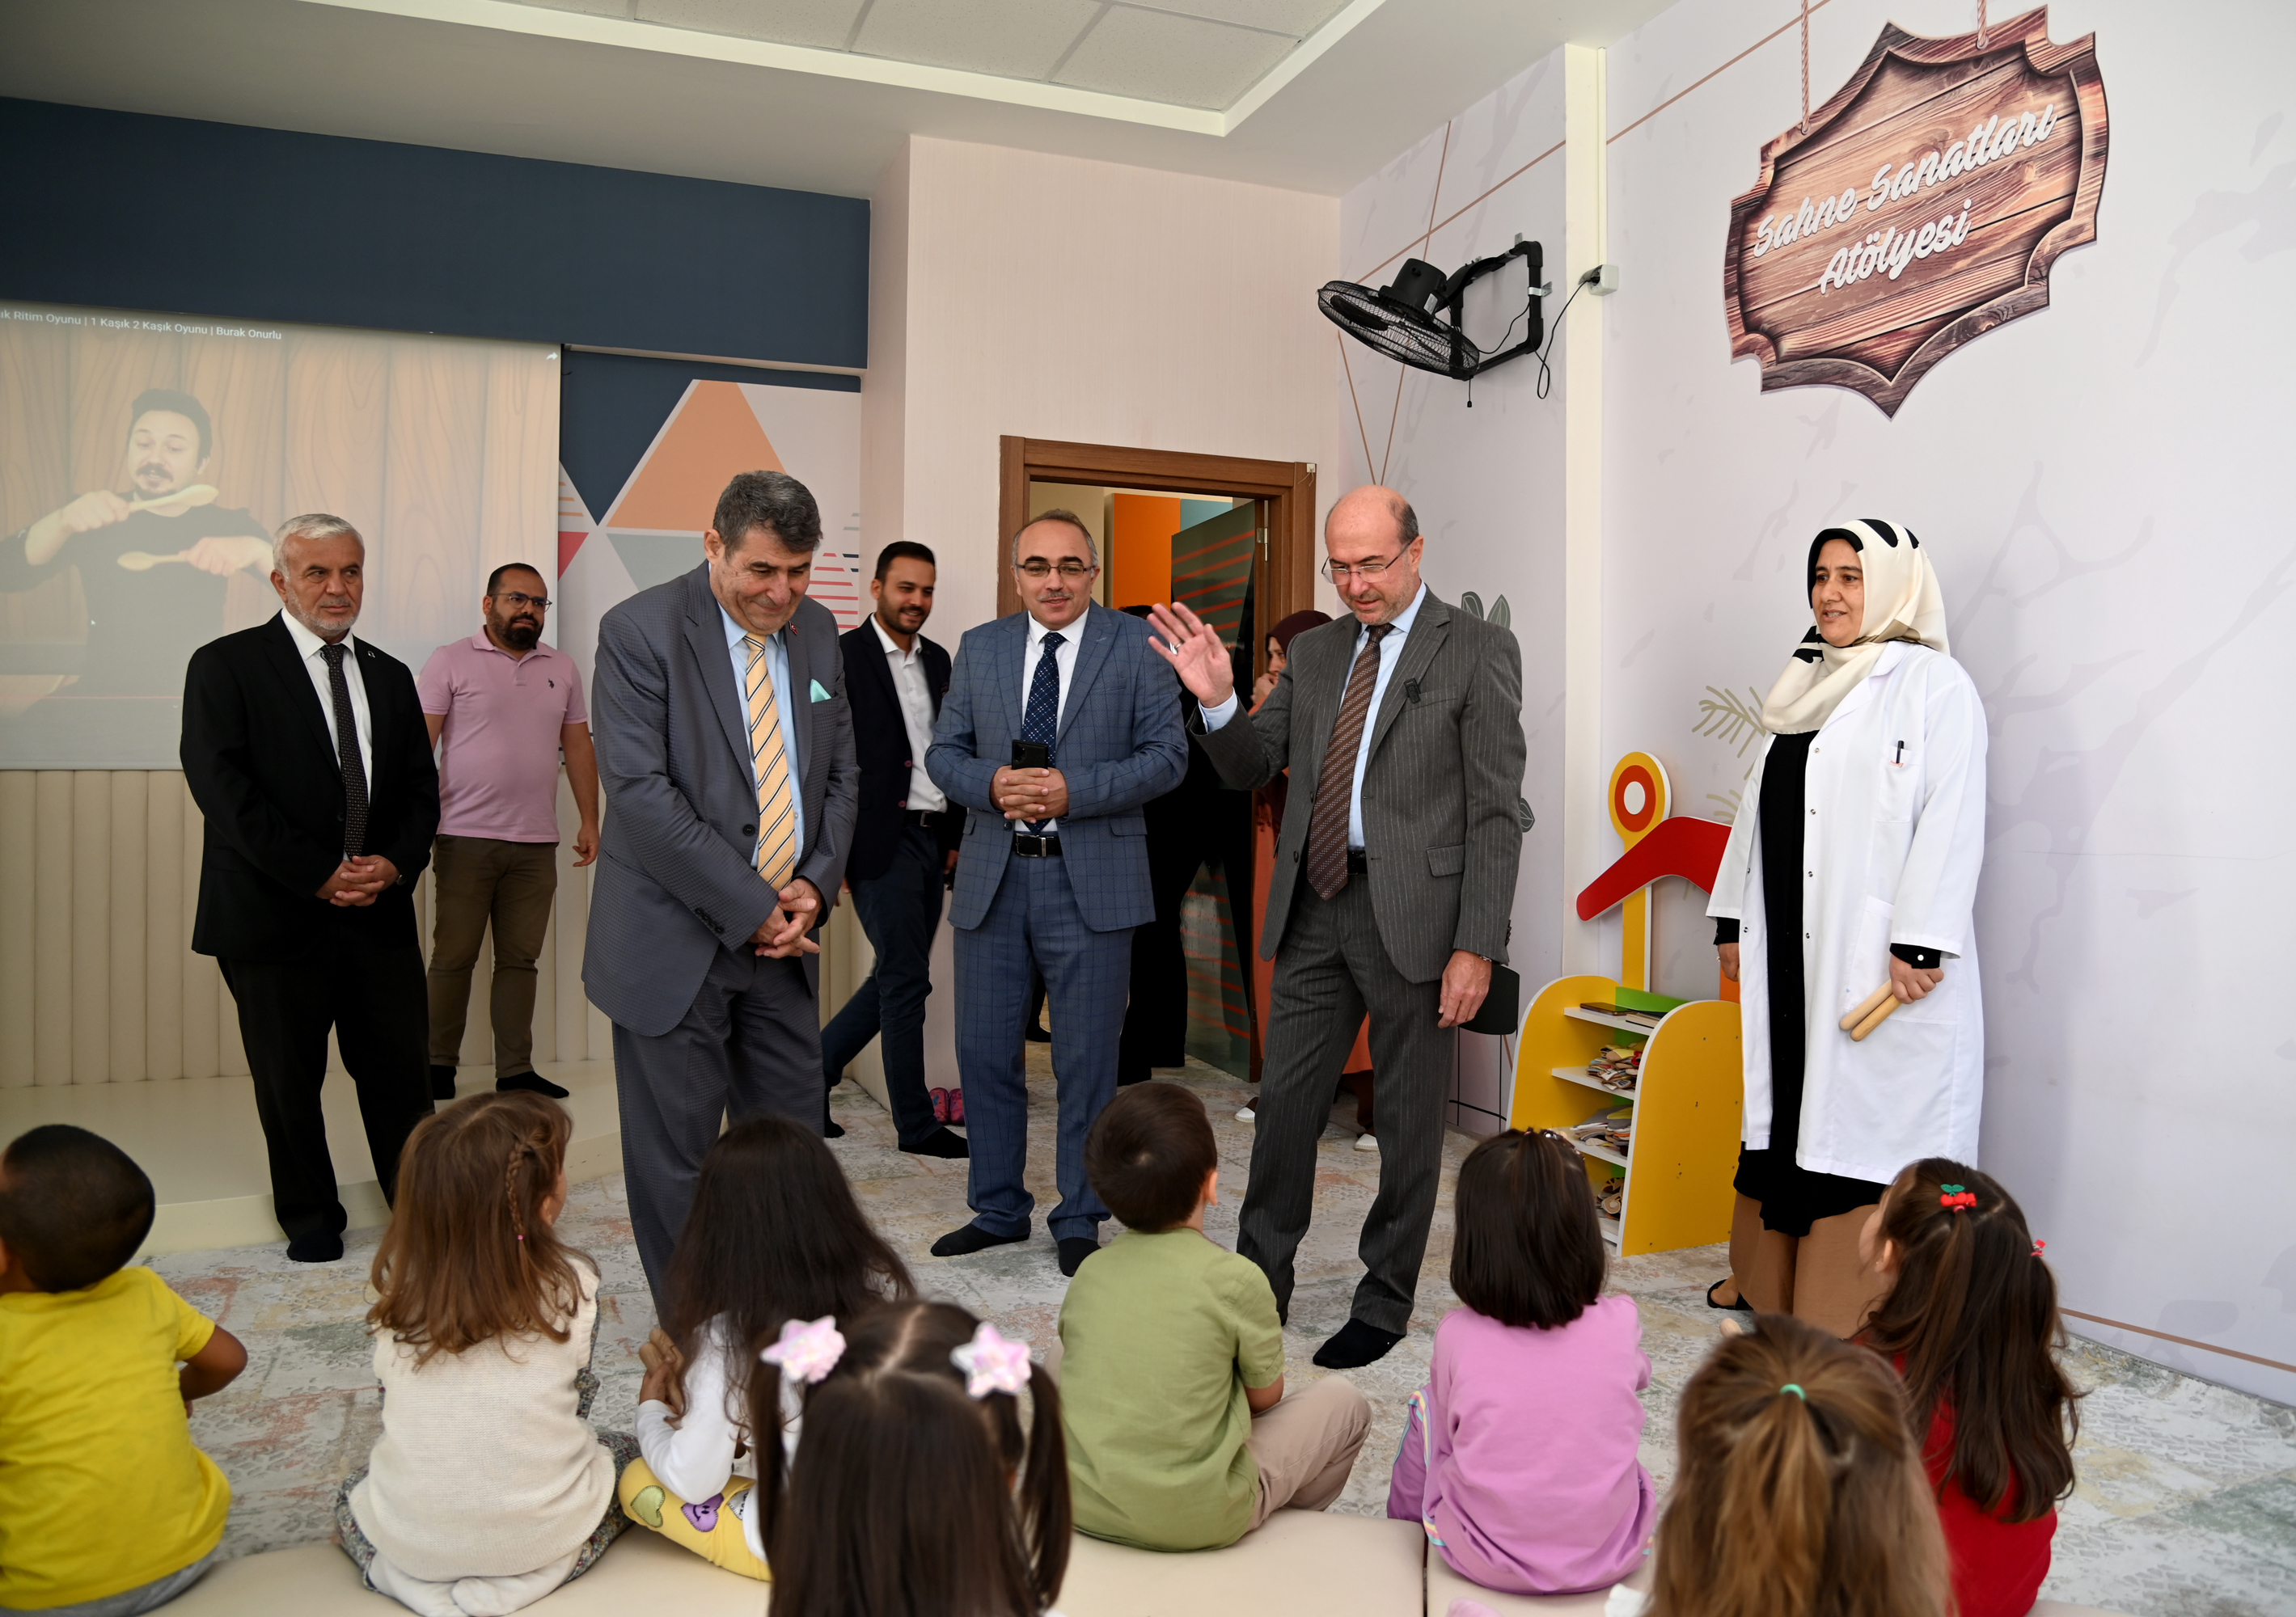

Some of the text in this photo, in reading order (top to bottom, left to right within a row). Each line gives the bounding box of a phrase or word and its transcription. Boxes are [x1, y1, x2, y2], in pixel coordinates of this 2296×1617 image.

[1753, 103, 2058, 259] Sahne Sanatları
[1816, 199, 1973, 294] Atölyesi
[14, 311, 43, 322] Ritim
[46, 314, 82, 325] Oyunu
[91, 318, 96, 326] 1
[100, 318, 130, 329] Kaşık
[133, 320, 140, 329] 2
[142, 321, 171, 332] Kaşık
[175, 323, 208, 335] Oyunu
[216, 327, 246, 337] Burak
[248, 329, 281, 340] Onurlu
